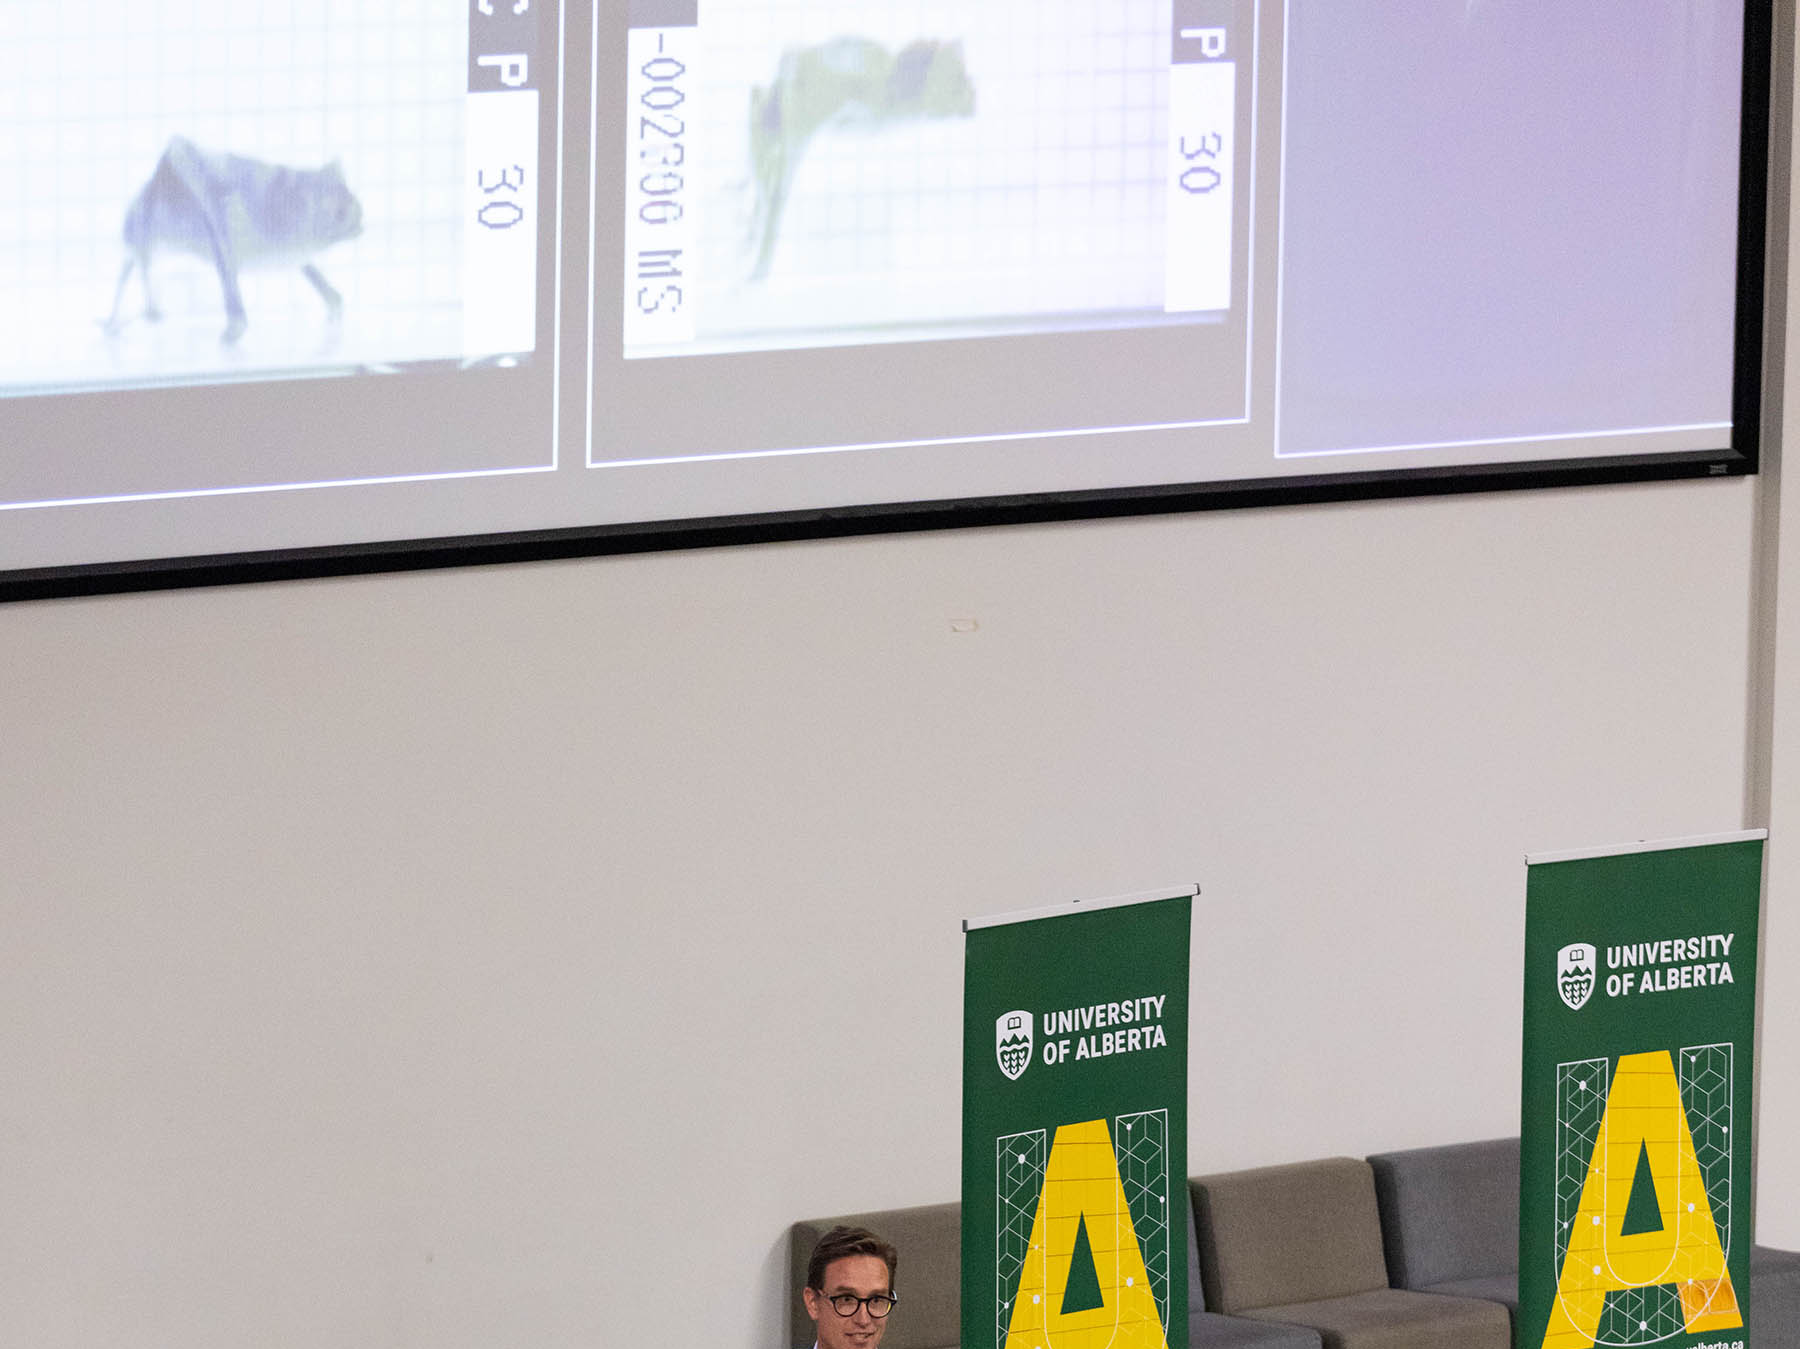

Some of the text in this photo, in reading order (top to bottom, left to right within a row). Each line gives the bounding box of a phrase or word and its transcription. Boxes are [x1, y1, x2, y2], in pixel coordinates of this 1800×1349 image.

[477, 54, 528, 87] P
[1180, 28, 1226, 193] P 30
[478, 164, 523, 230] 30
[638, 249, 682, 314] MS
[1607, 933, 1734, 968] UNIVERSITY
[1606, 962, 1734, 997] OF ALBERTA
[1044, 995, 1165, 1035] UNIVERSITY
[1043, 1025, 1166, 1065] OF ALBERTA
